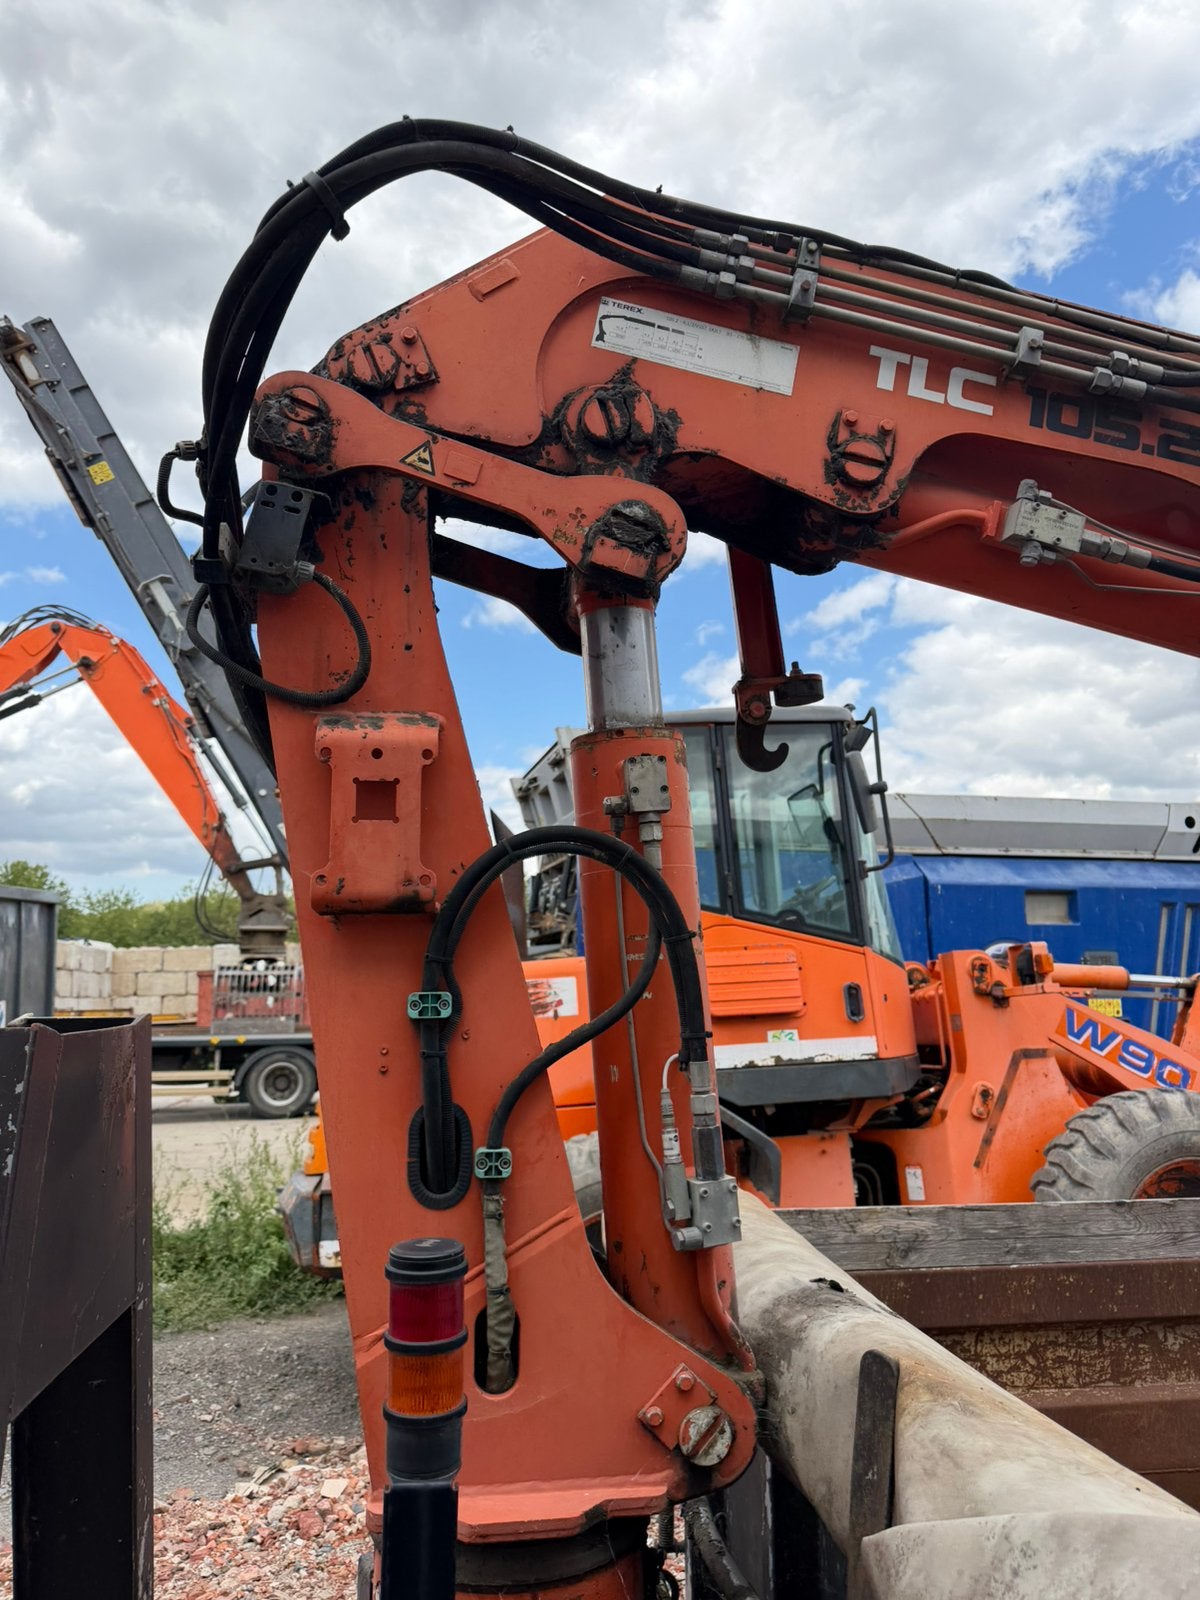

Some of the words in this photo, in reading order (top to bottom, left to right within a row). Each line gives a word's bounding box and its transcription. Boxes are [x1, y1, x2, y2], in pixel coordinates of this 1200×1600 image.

[610, 302, 643, 314] TEREX
[869, 345, 997, 416] TLC
[1025, 387, 1200, 467] 105.2
[1066, 1008, 1191, 1090] W90
